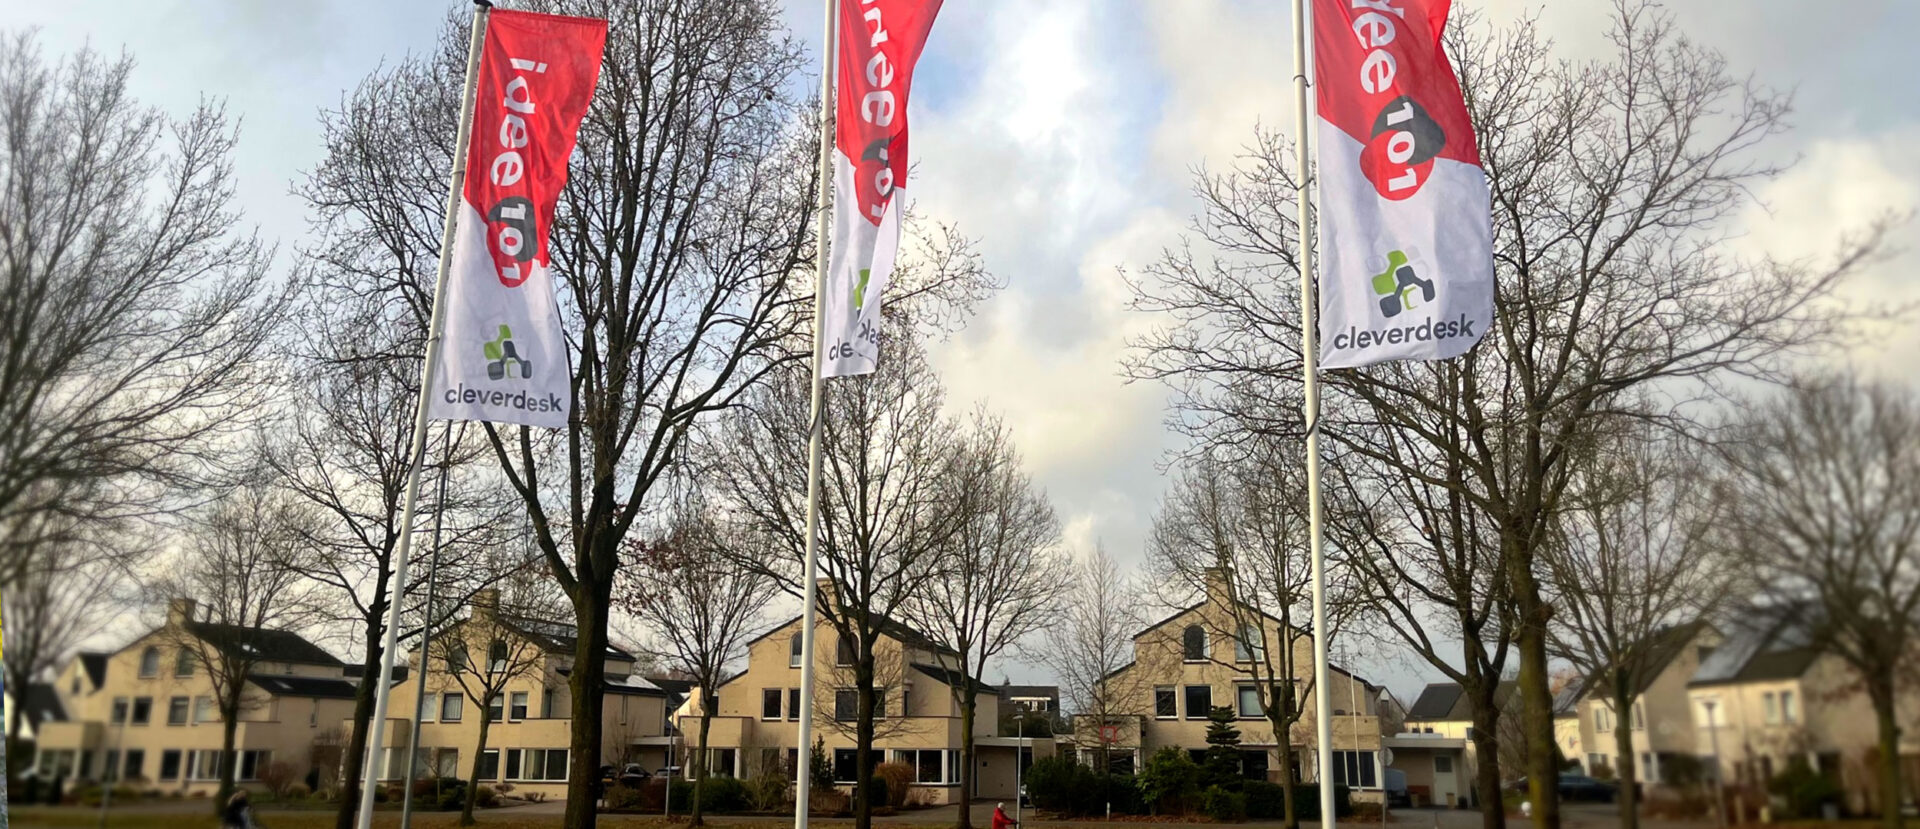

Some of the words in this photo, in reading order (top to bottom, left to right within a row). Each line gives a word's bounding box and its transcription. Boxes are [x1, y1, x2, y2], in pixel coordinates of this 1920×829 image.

[490, 58, 548, 187] idee
[1386, 101, 1418, 192] 101
[500, 203, 527, 280] 101
[1333, 312, 1475, 350] cleverdesk
[444, 382, 563, 413] cleverdesk
